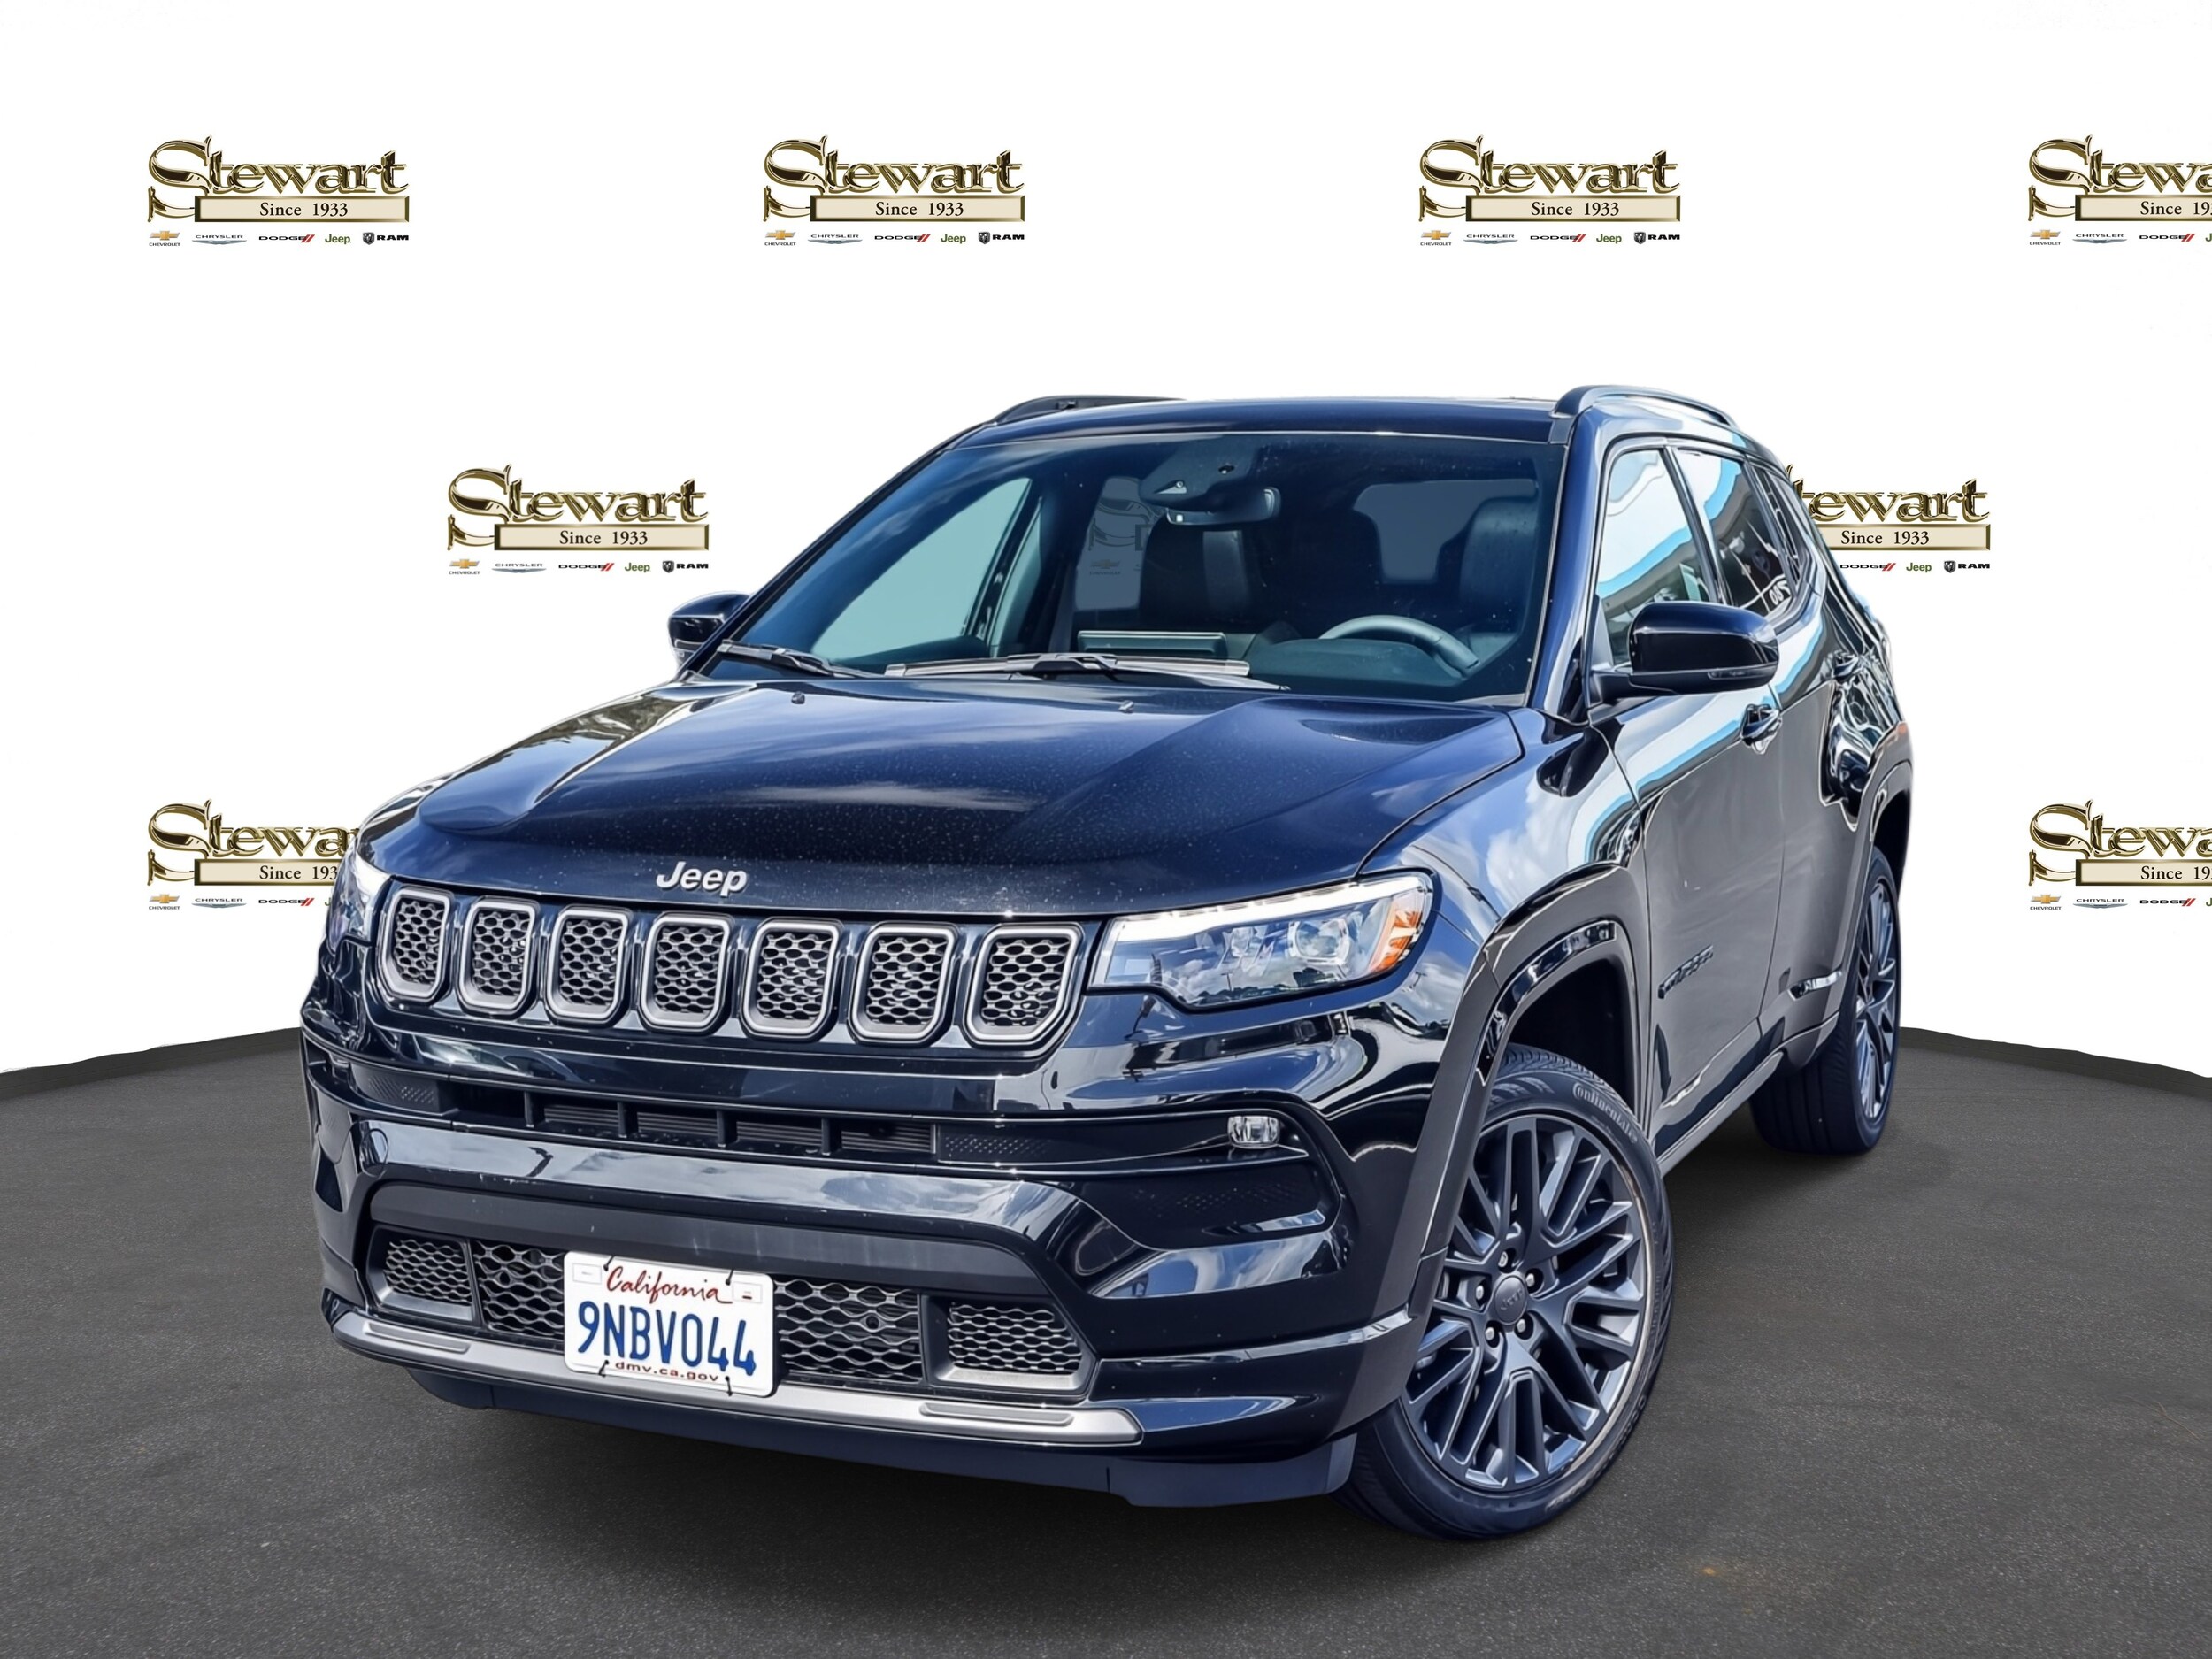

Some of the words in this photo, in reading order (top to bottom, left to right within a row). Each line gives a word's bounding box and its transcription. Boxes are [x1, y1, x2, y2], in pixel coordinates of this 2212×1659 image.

[148, 135, 409, 222] Stewart
[764, 134, 1025, 221] Stewart
[1419, 134, 1680, 221] Stewart
[2028, 134, 2212, 221] Stew
[260, 202, 302, 217] Since
[312, 202, 349, 217] 1933
[876, 201, 918, 216] Since
[928, 201, 964, 216] 1933
[1532, 201, 1573, 216] Since
[1584, 201, 1620, 216] 1933
[2140, 201, 2182, 216] Since
[2193, 201, 2212, 216] 19
[325, 234, 351, 245] Jeep
[941, 233, 967, 244] Jeep
[1596, 233, 1623, 244] Jeep
[448, 464, 709, 550] Stewart
[560, 530, 602, 545] Since
[612, 530, 649, 545] 1933
[1841, 530, 1883, 545] Since
[1893, 530, 1930, 545] 1933
[625, 562, 651, 573] Jeep
[1906, 562, 1932, 573] Jeep
[2029, 799, 2212, 886] Stew
[260, 865, 302, 880] Since
[312, 865, 338, 880] 193
[656, 861, 749, 898] Jeep
[2141, 865, 2183, 880] Since
[2193, 865, 2212, 880] 19
[1572, 1081, 1639, 1144] Continental
[606, 1266, 733, 1304] California
[578, 1301, 757, 1377] 9NBV044
[615, 1361, 719, 1382] dmv.ca.gov
